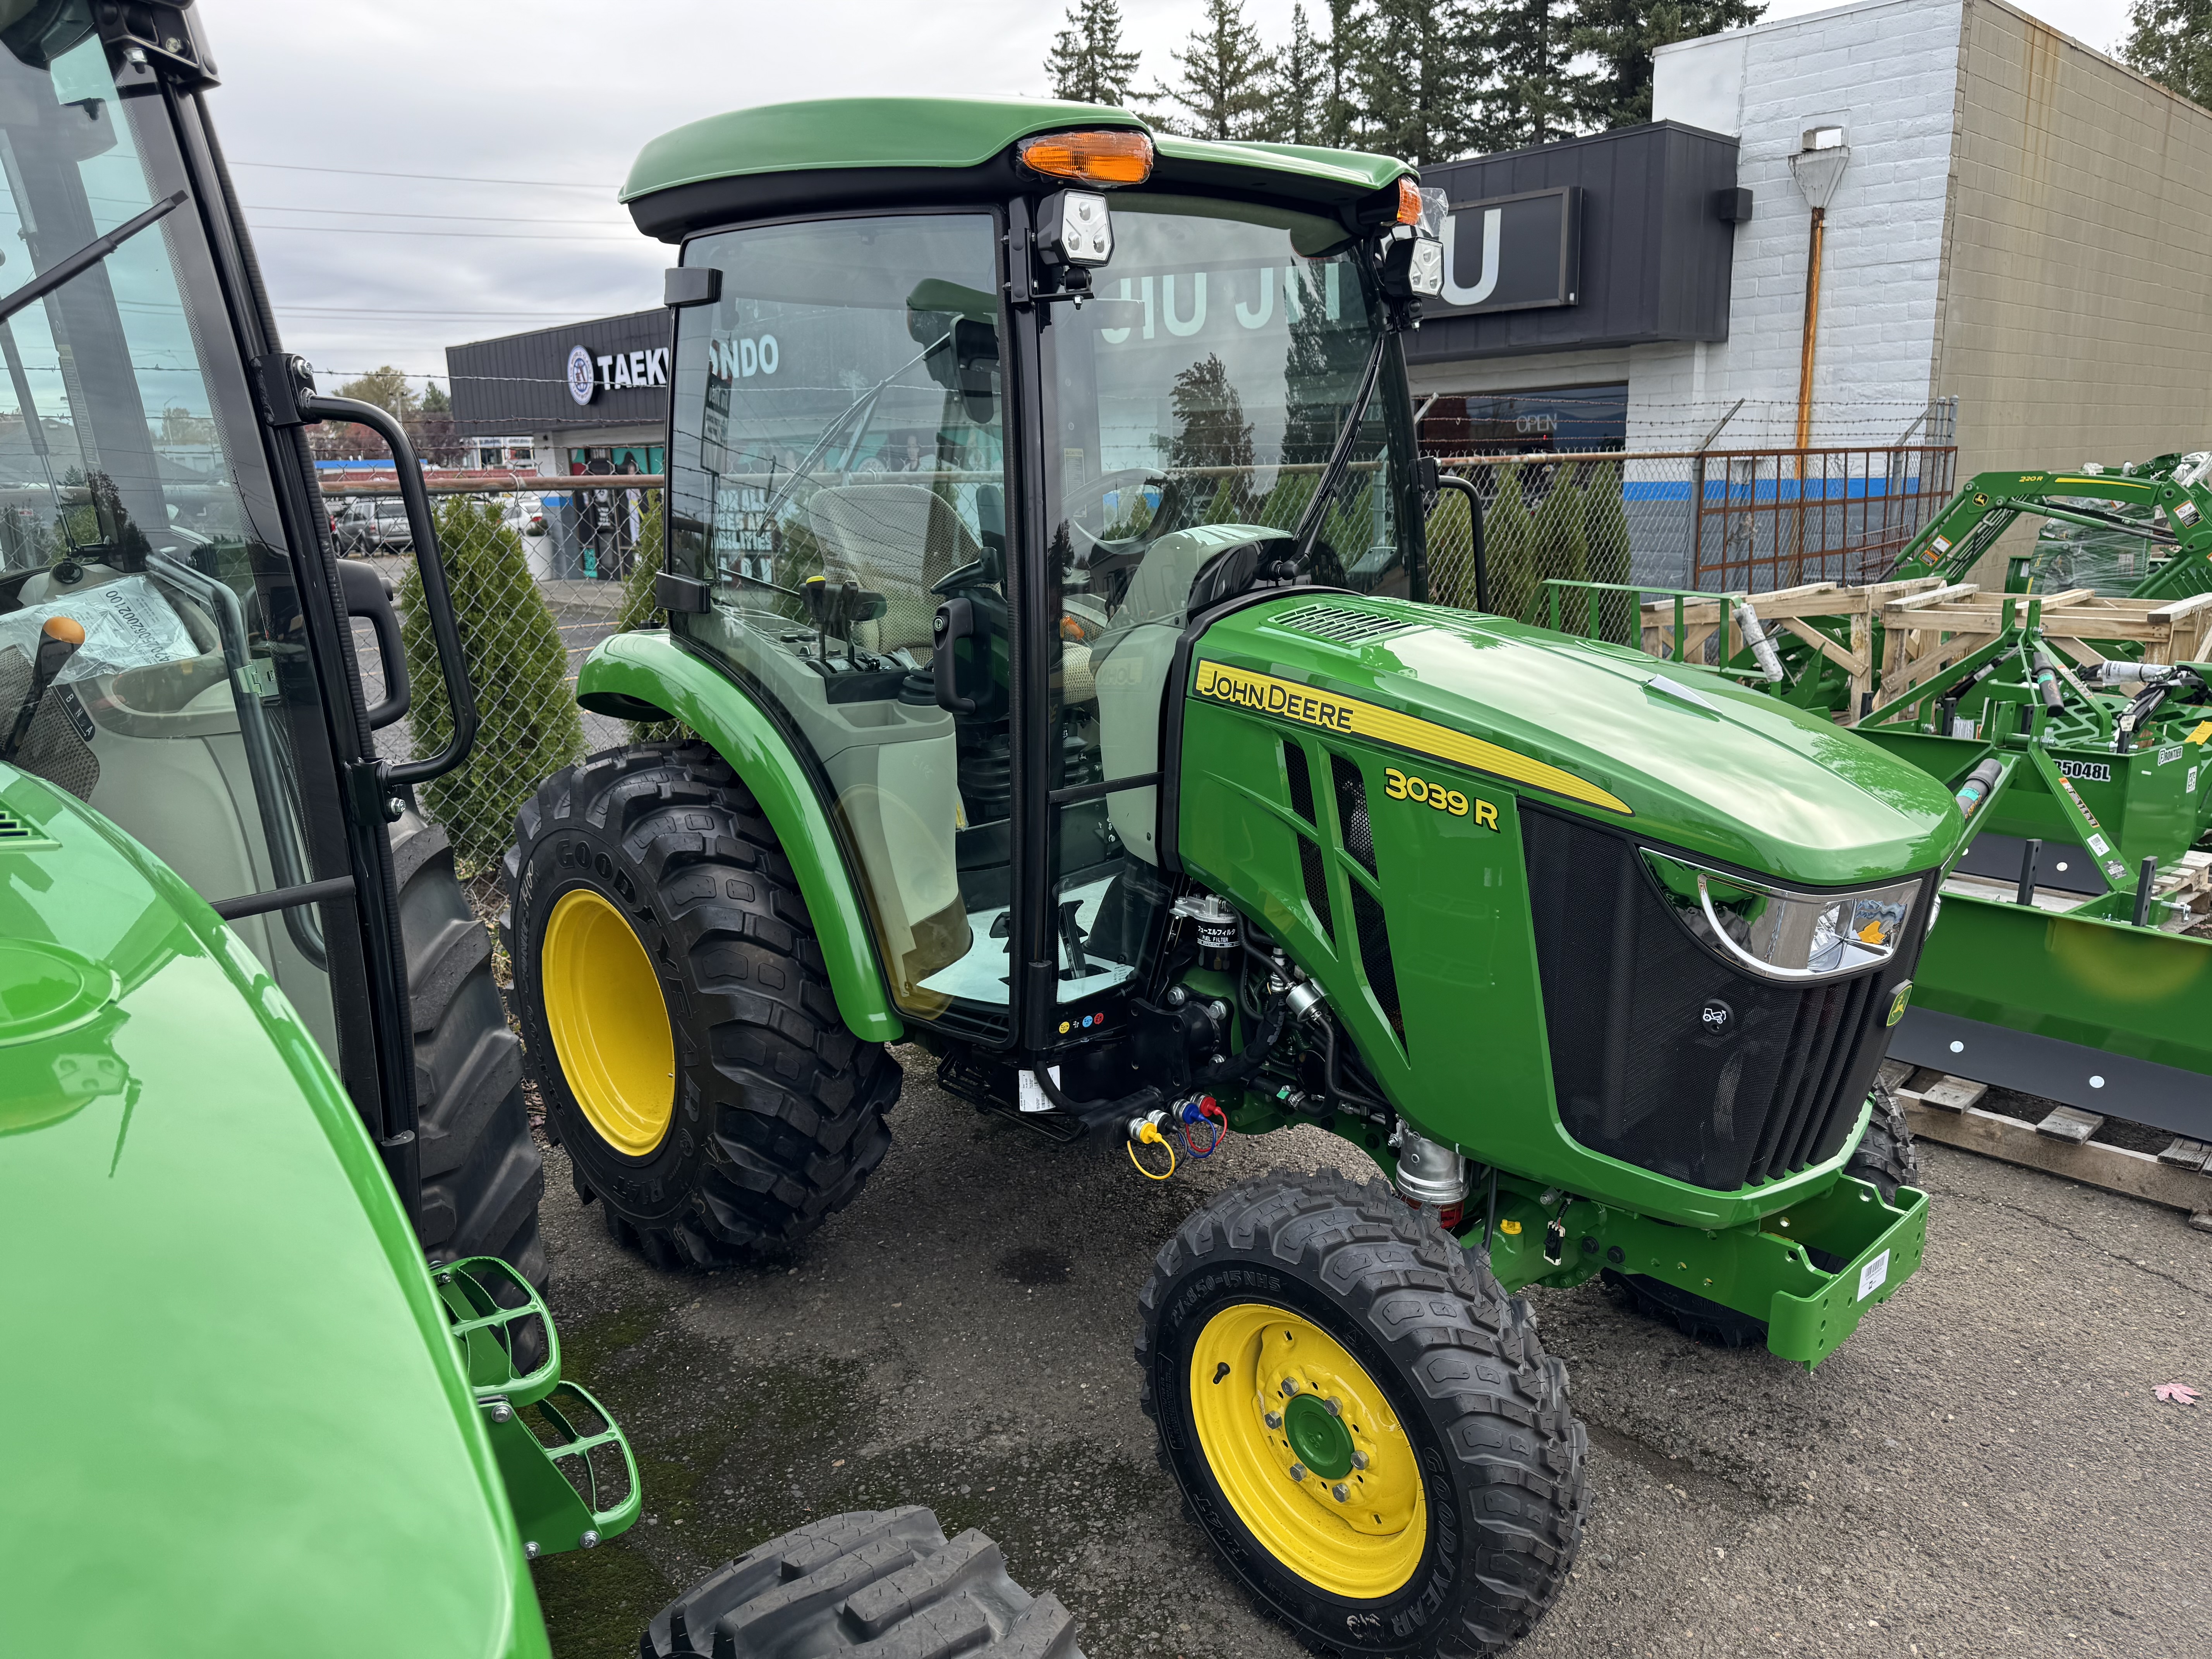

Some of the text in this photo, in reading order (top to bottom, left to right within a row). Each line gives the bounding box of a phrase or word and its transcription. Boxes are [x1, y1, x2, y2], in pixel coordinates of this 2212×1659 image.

[597, 334, 779, 390] TAEKNDO
[1516, 413, 1558, 433] OPEN
[1203, 670, 1355, 731] JOHN DEERE
[2159, 747, 2182, 764] FRONTIER
[1384, 767, 1500, 833] 3039 R
[1198, 925, 1235, 936] フューエルフィルタ
[556, 838, 701, 1122] GOODYEAR
[1391, 1446, 1458, 1637] GOODYEAR
